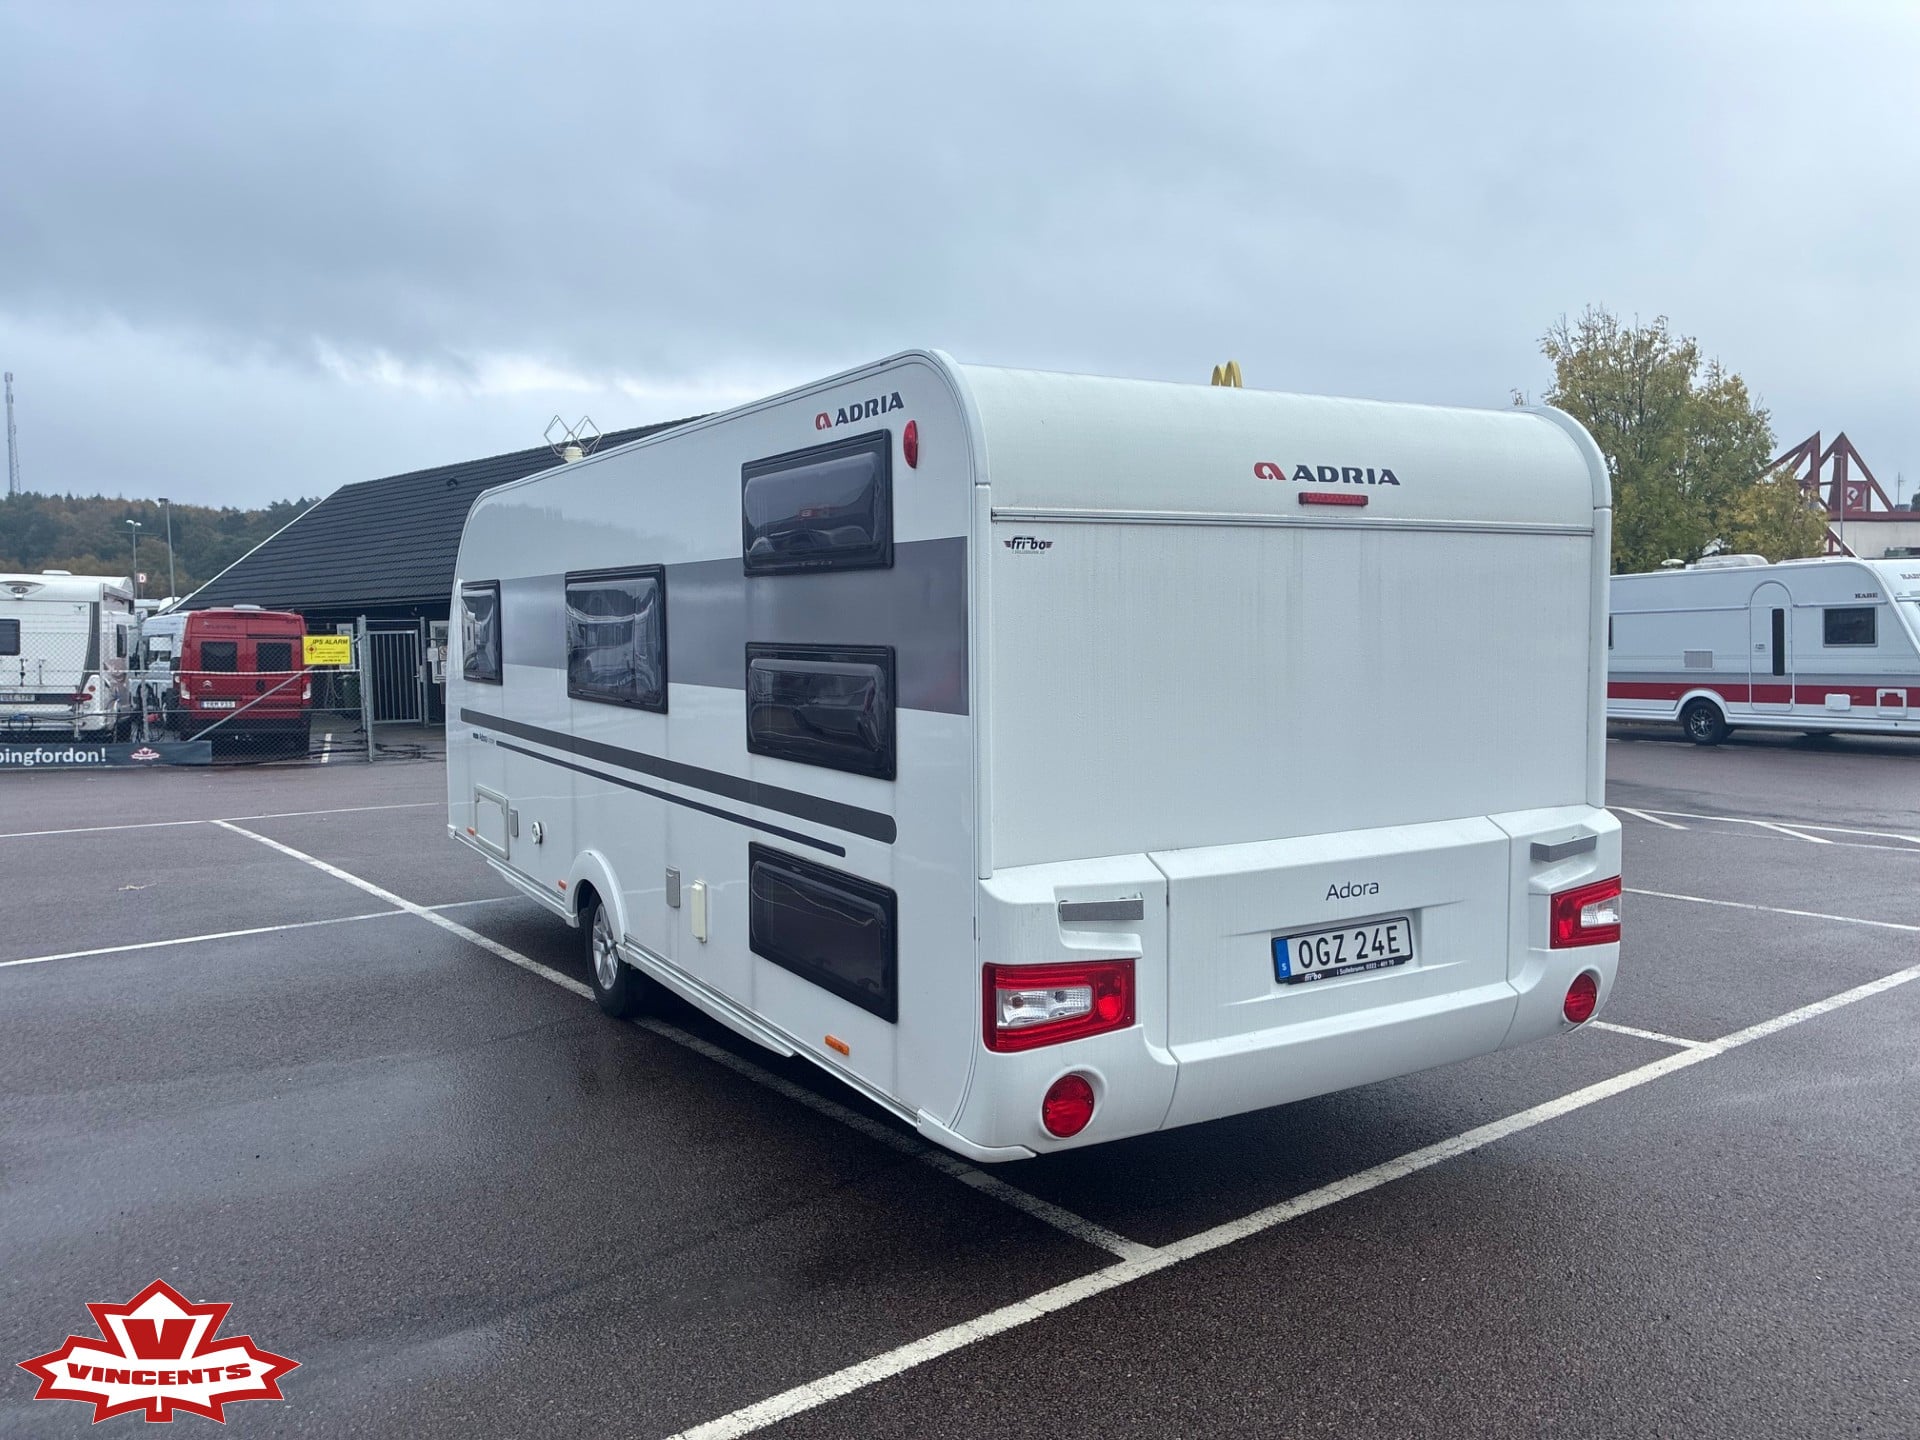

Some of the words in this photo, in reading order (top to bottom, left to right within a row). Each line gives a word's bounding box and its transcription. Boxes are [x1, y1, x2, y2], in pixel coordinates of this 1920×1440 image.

[835, 391, 904, 426] ADRIA
[1292, 464, 1401, 486] ADRIA
[1325, 881, 1379, 901] Adora
[1298, 933, 1347, 969] OGZ
[1354, 925, 1400, 960] 24E
